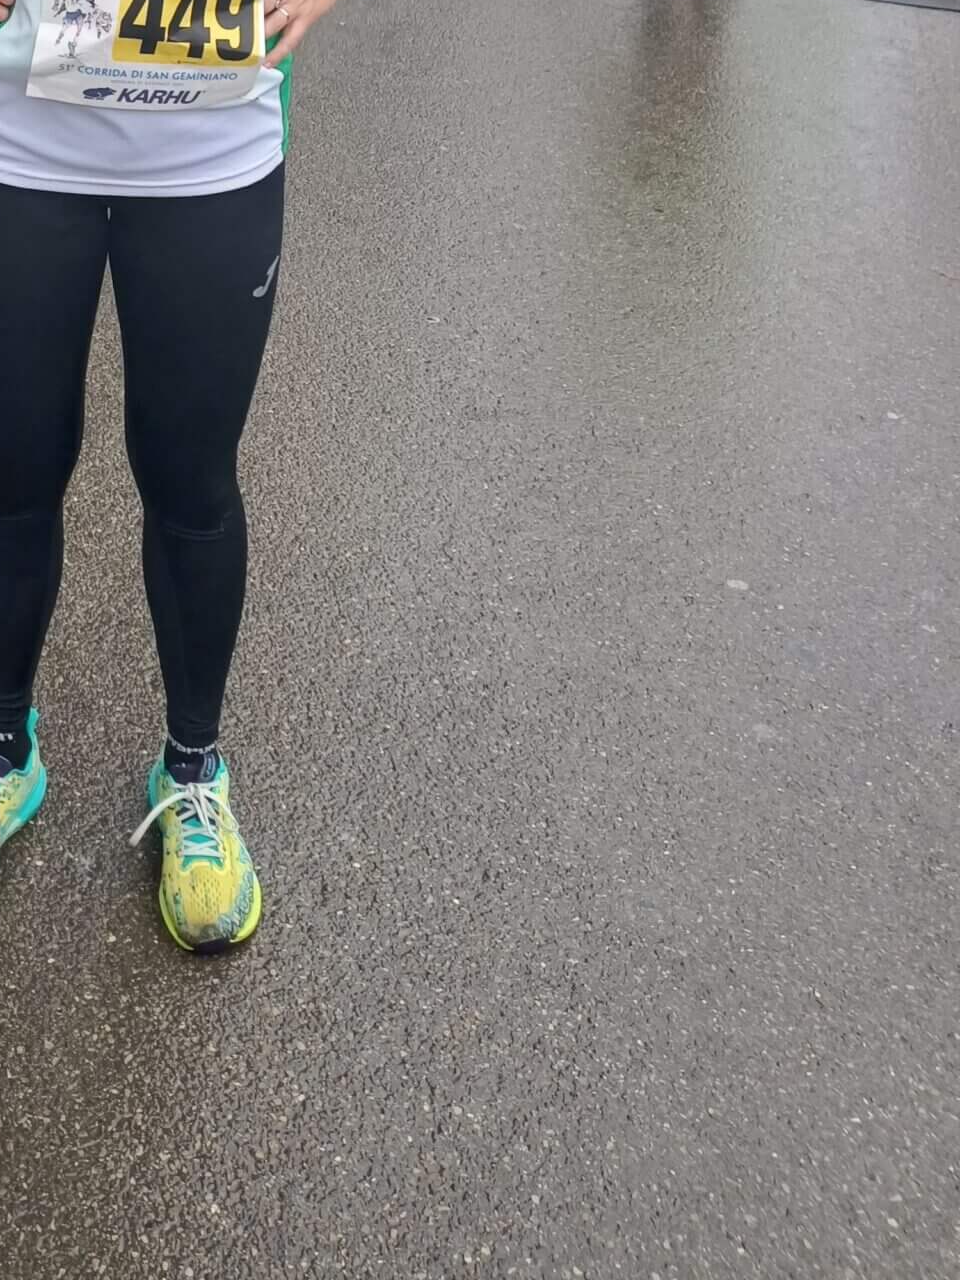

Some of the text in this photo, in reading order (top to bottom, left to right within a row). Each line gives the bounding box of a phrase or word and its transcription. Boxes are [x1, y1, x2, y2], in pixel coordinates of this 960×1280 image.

[78, 65, 128, 79] CORRIDA
[131, 70, 144, 80] DI
[147, 71, 169, 80] SAN
[172, 71, 238, 81] GEMINIANO
[117, 87, 202, 105] KARHU
